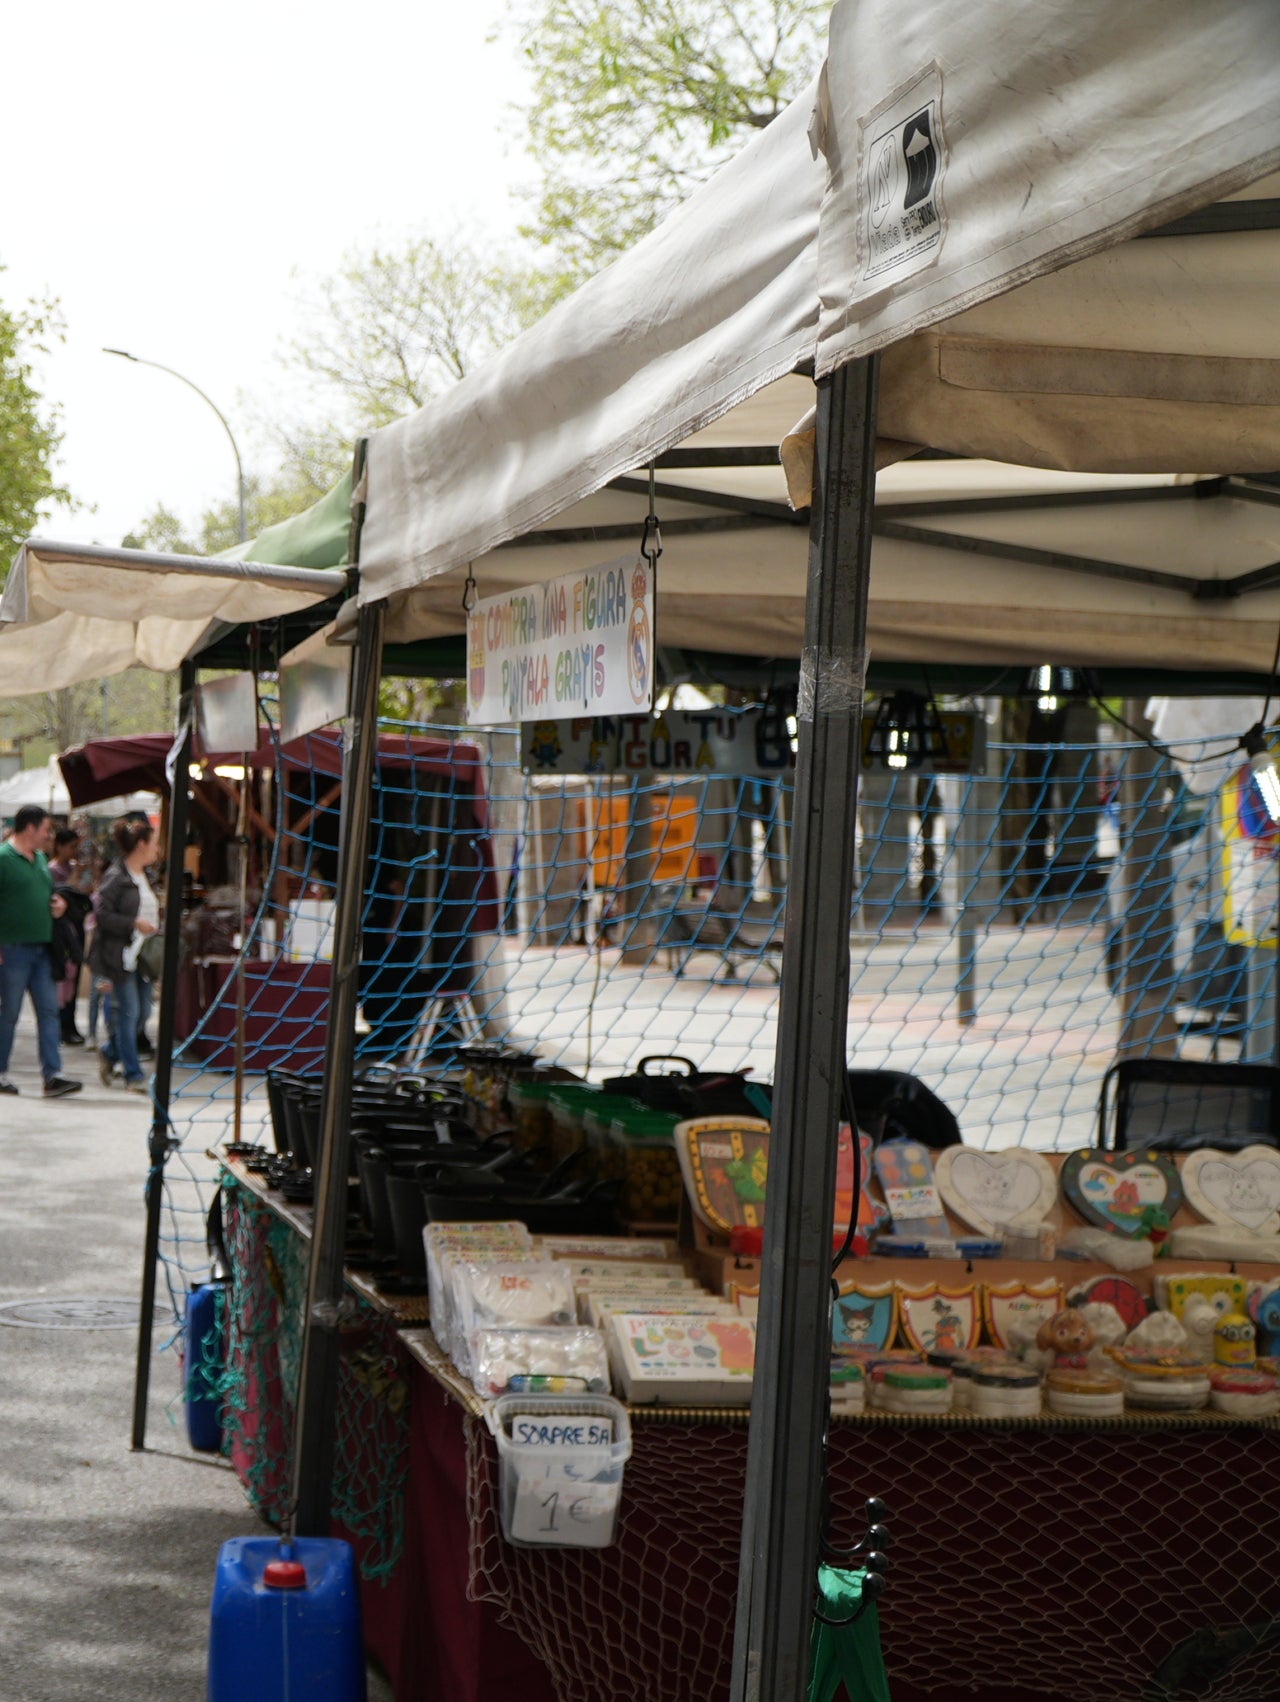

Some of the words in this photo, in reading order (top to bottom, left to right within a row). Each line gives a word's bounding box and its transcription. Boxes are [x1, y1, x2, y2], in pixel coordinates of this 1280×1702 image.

[486, 593, 537, 652] COMPRA
[542, 583, 567, 640] UNA
[573, 568, 627, 634] FIGURA
[588, 740, 717, 770] FIGURA
[517, 1423, 610, 1446] SORPRESA
